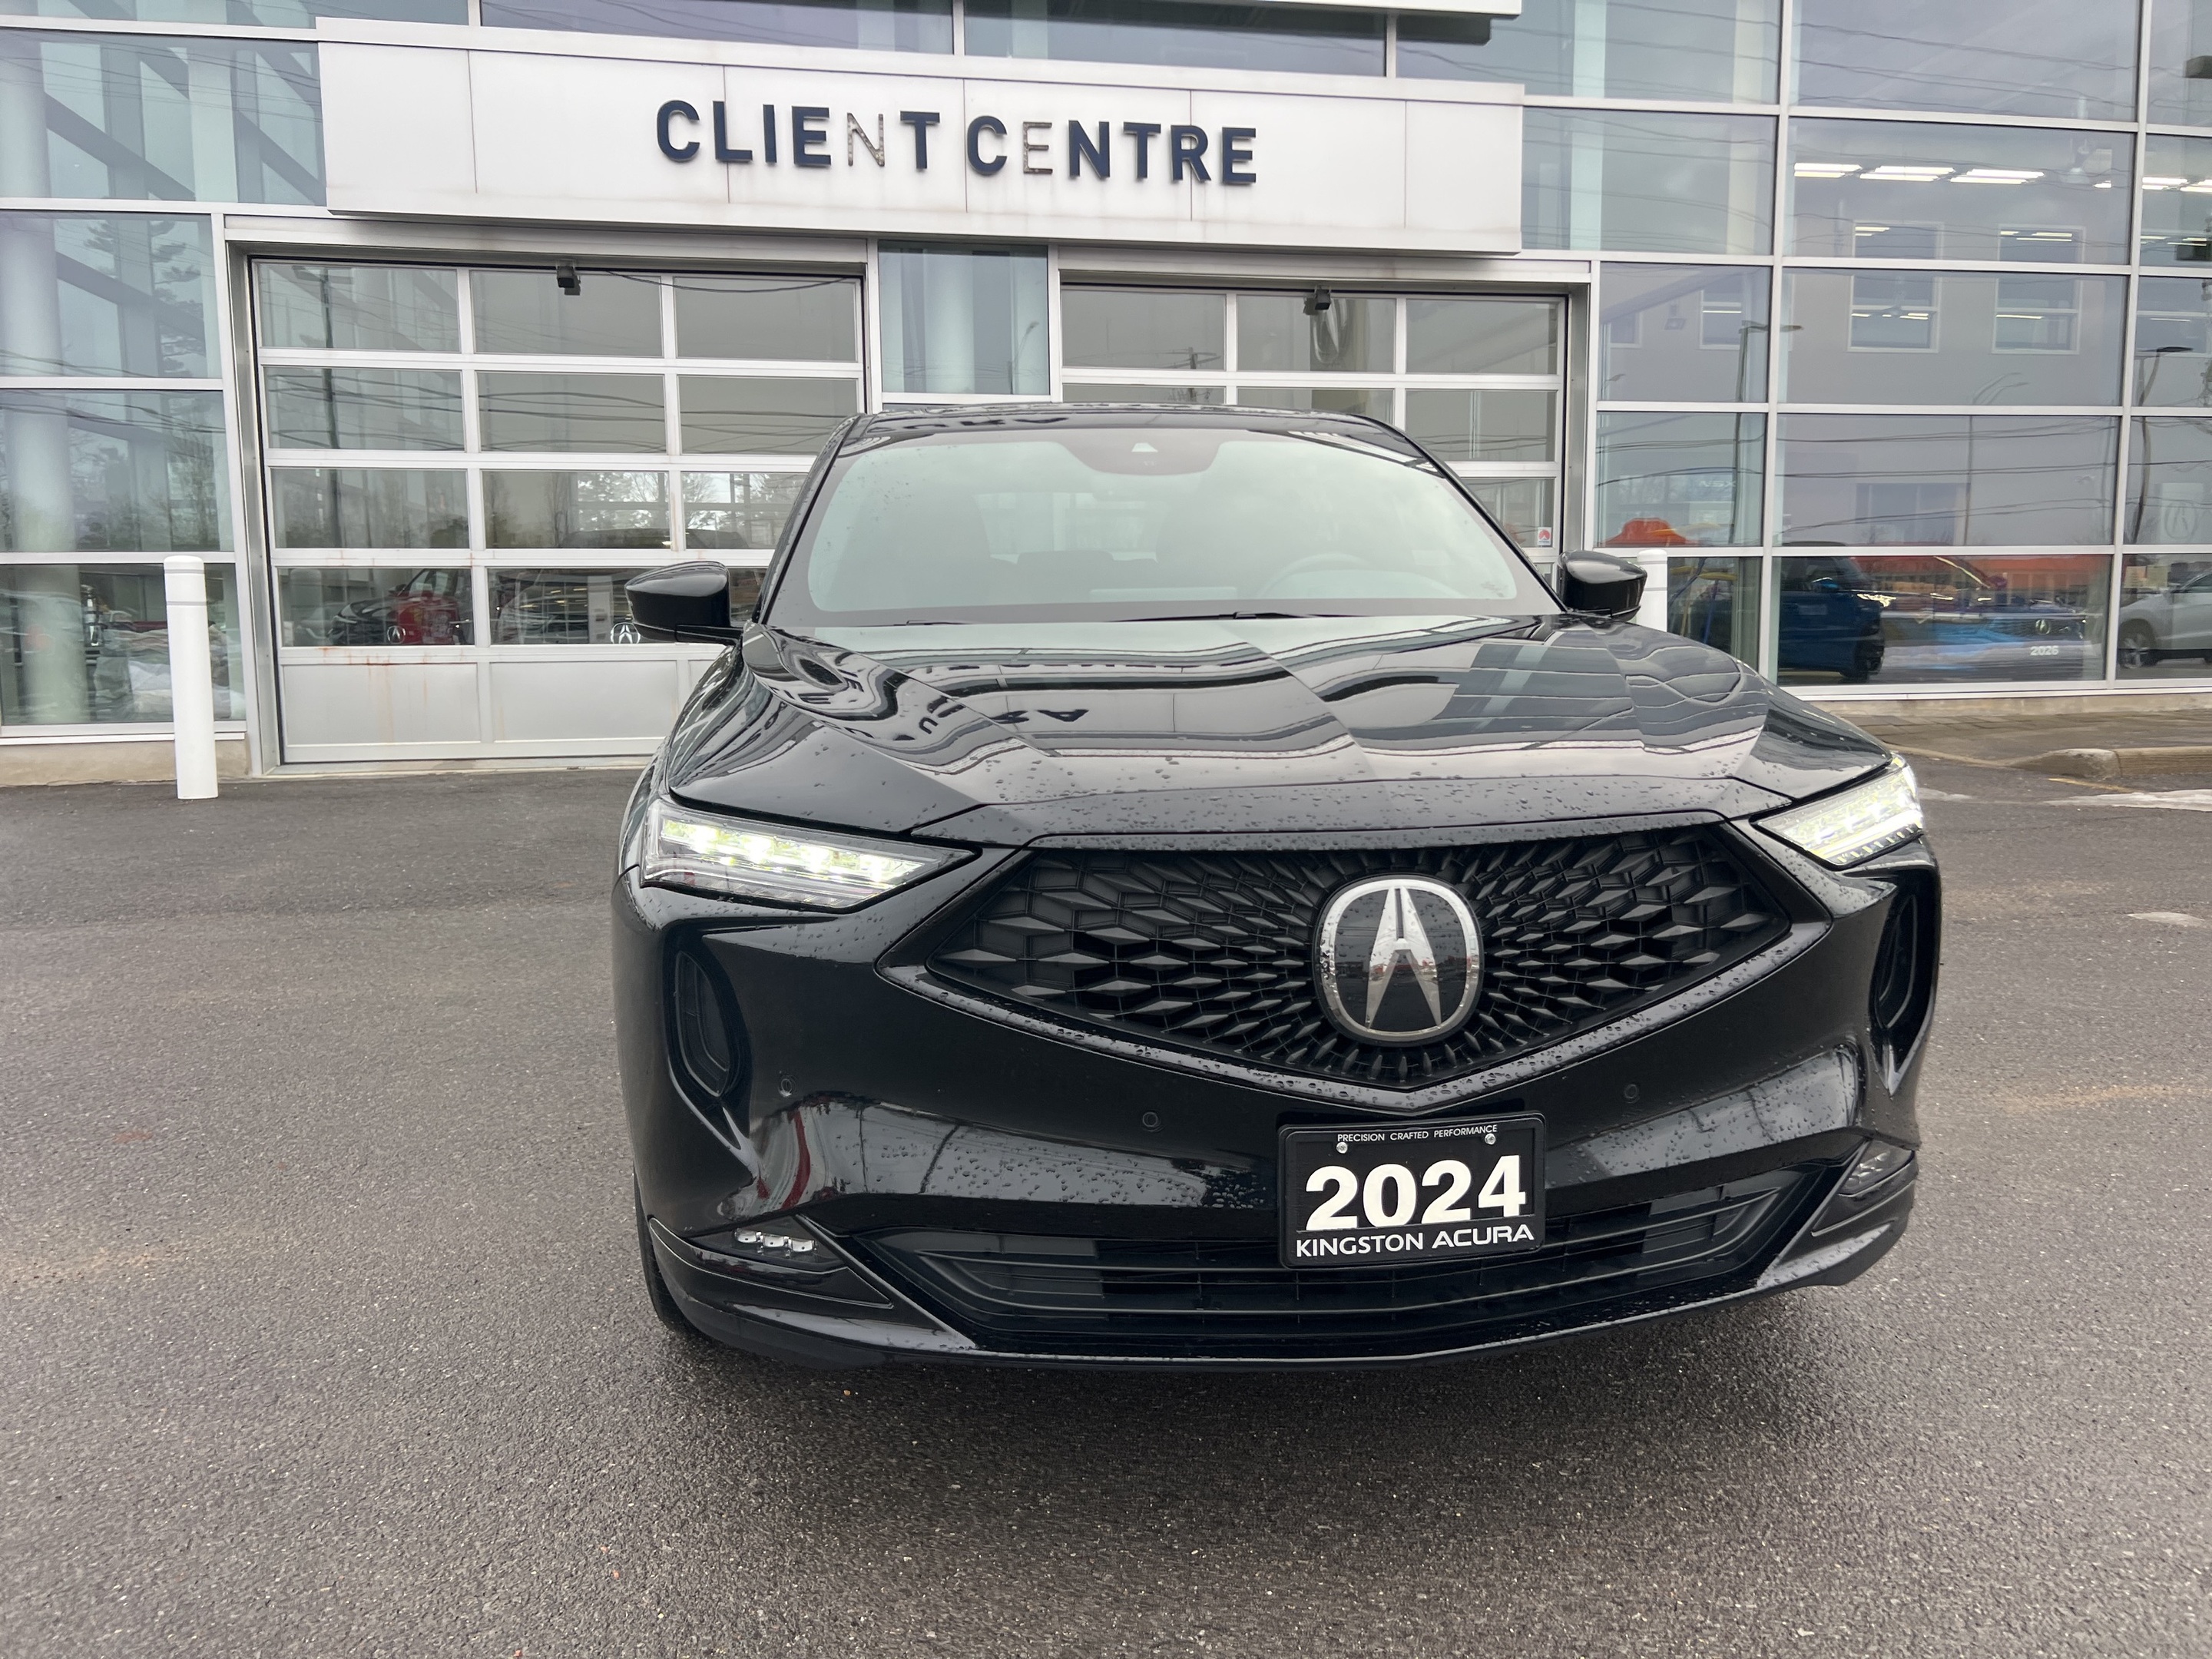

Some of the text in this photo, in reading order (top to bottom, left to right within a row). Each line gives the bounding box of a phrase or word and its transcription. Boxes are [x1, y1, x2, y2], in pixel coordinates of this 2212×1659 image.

[657, 100, 1257, 185] CLIENT CENTRE
[1337, 1124, 1498, 1142] PRECISION CRAFTED PERFORMANCE
[1306, 1154, 1526, 1231] 2024
[1296, 1224, 1535, 1257] KINGSTON ACURA
